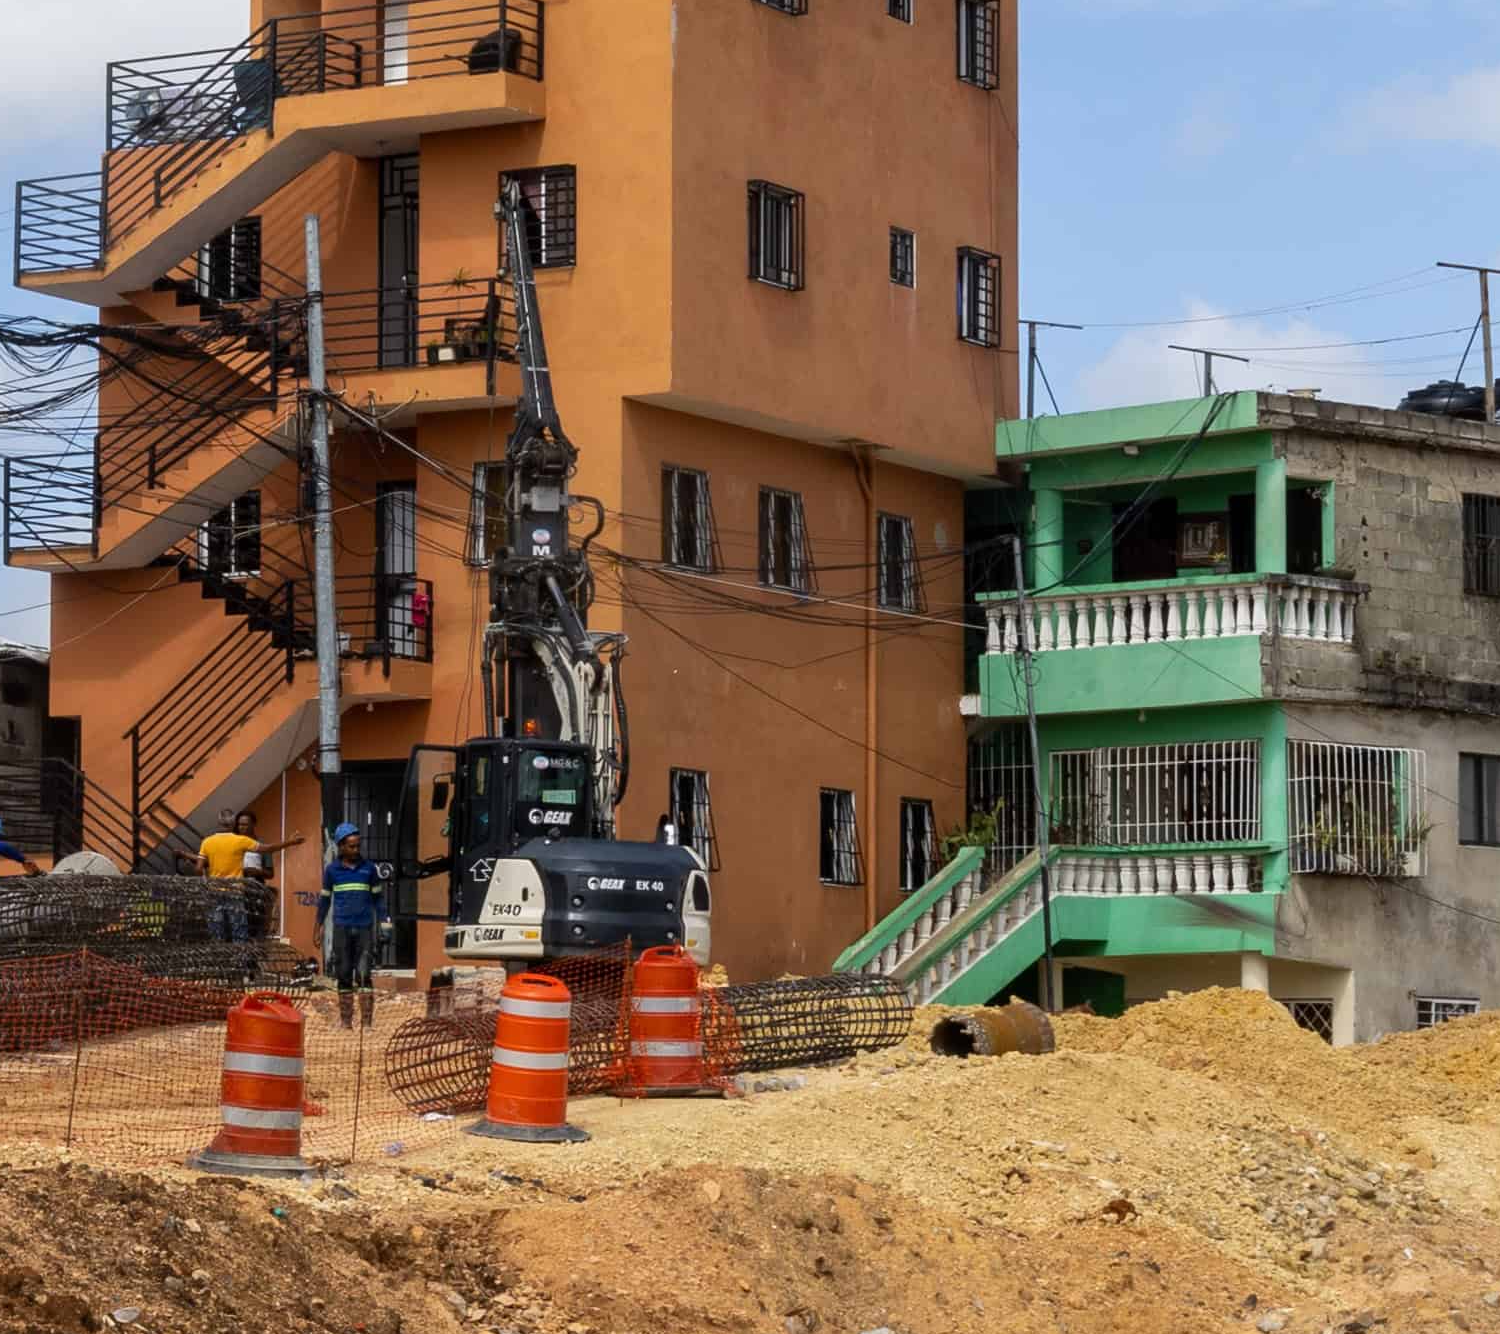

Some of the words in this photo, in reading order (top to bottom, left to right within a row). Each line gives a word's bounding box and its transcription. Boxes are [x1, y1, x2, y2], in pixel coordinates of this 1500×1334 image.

[544, 810, 573, 826] GEAX
[600, 878, 626, 891] GEAX
[635, 879, 650, 891] EK
[651, 880, 664, 892] 40
[492, 904, 522, 916] EK40
[482, 928, 505, 941] GEAX
